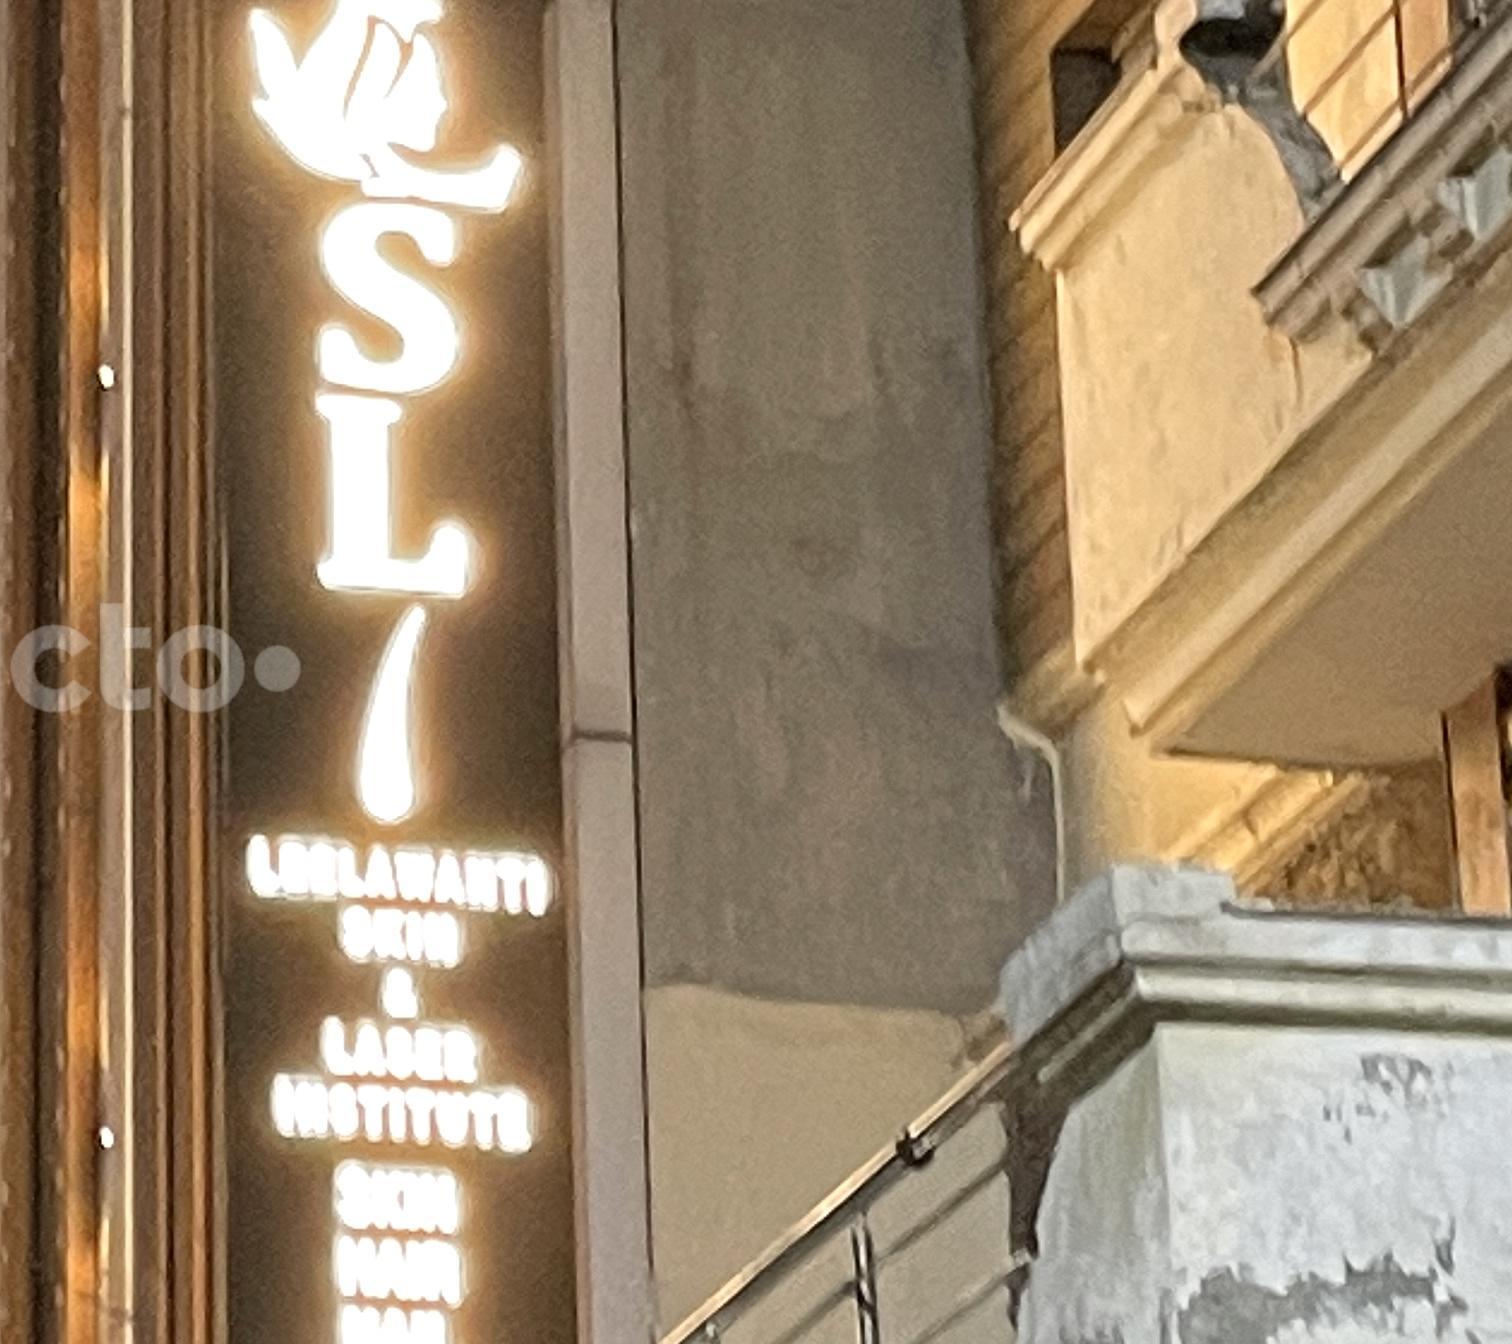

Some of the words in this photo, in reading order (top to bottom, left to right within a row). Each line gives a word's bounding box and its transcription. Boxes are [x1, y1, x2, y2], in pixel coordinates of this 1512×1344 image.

[341, 904, 462, 968] SKIN
[321, 1016, 479, 1083] LASER
[273, 1074, 533, 1152] INSTITUTE
[334, 1160, 461, 1234] SKIN
[335, 1233, 462, 1306] HAIR
